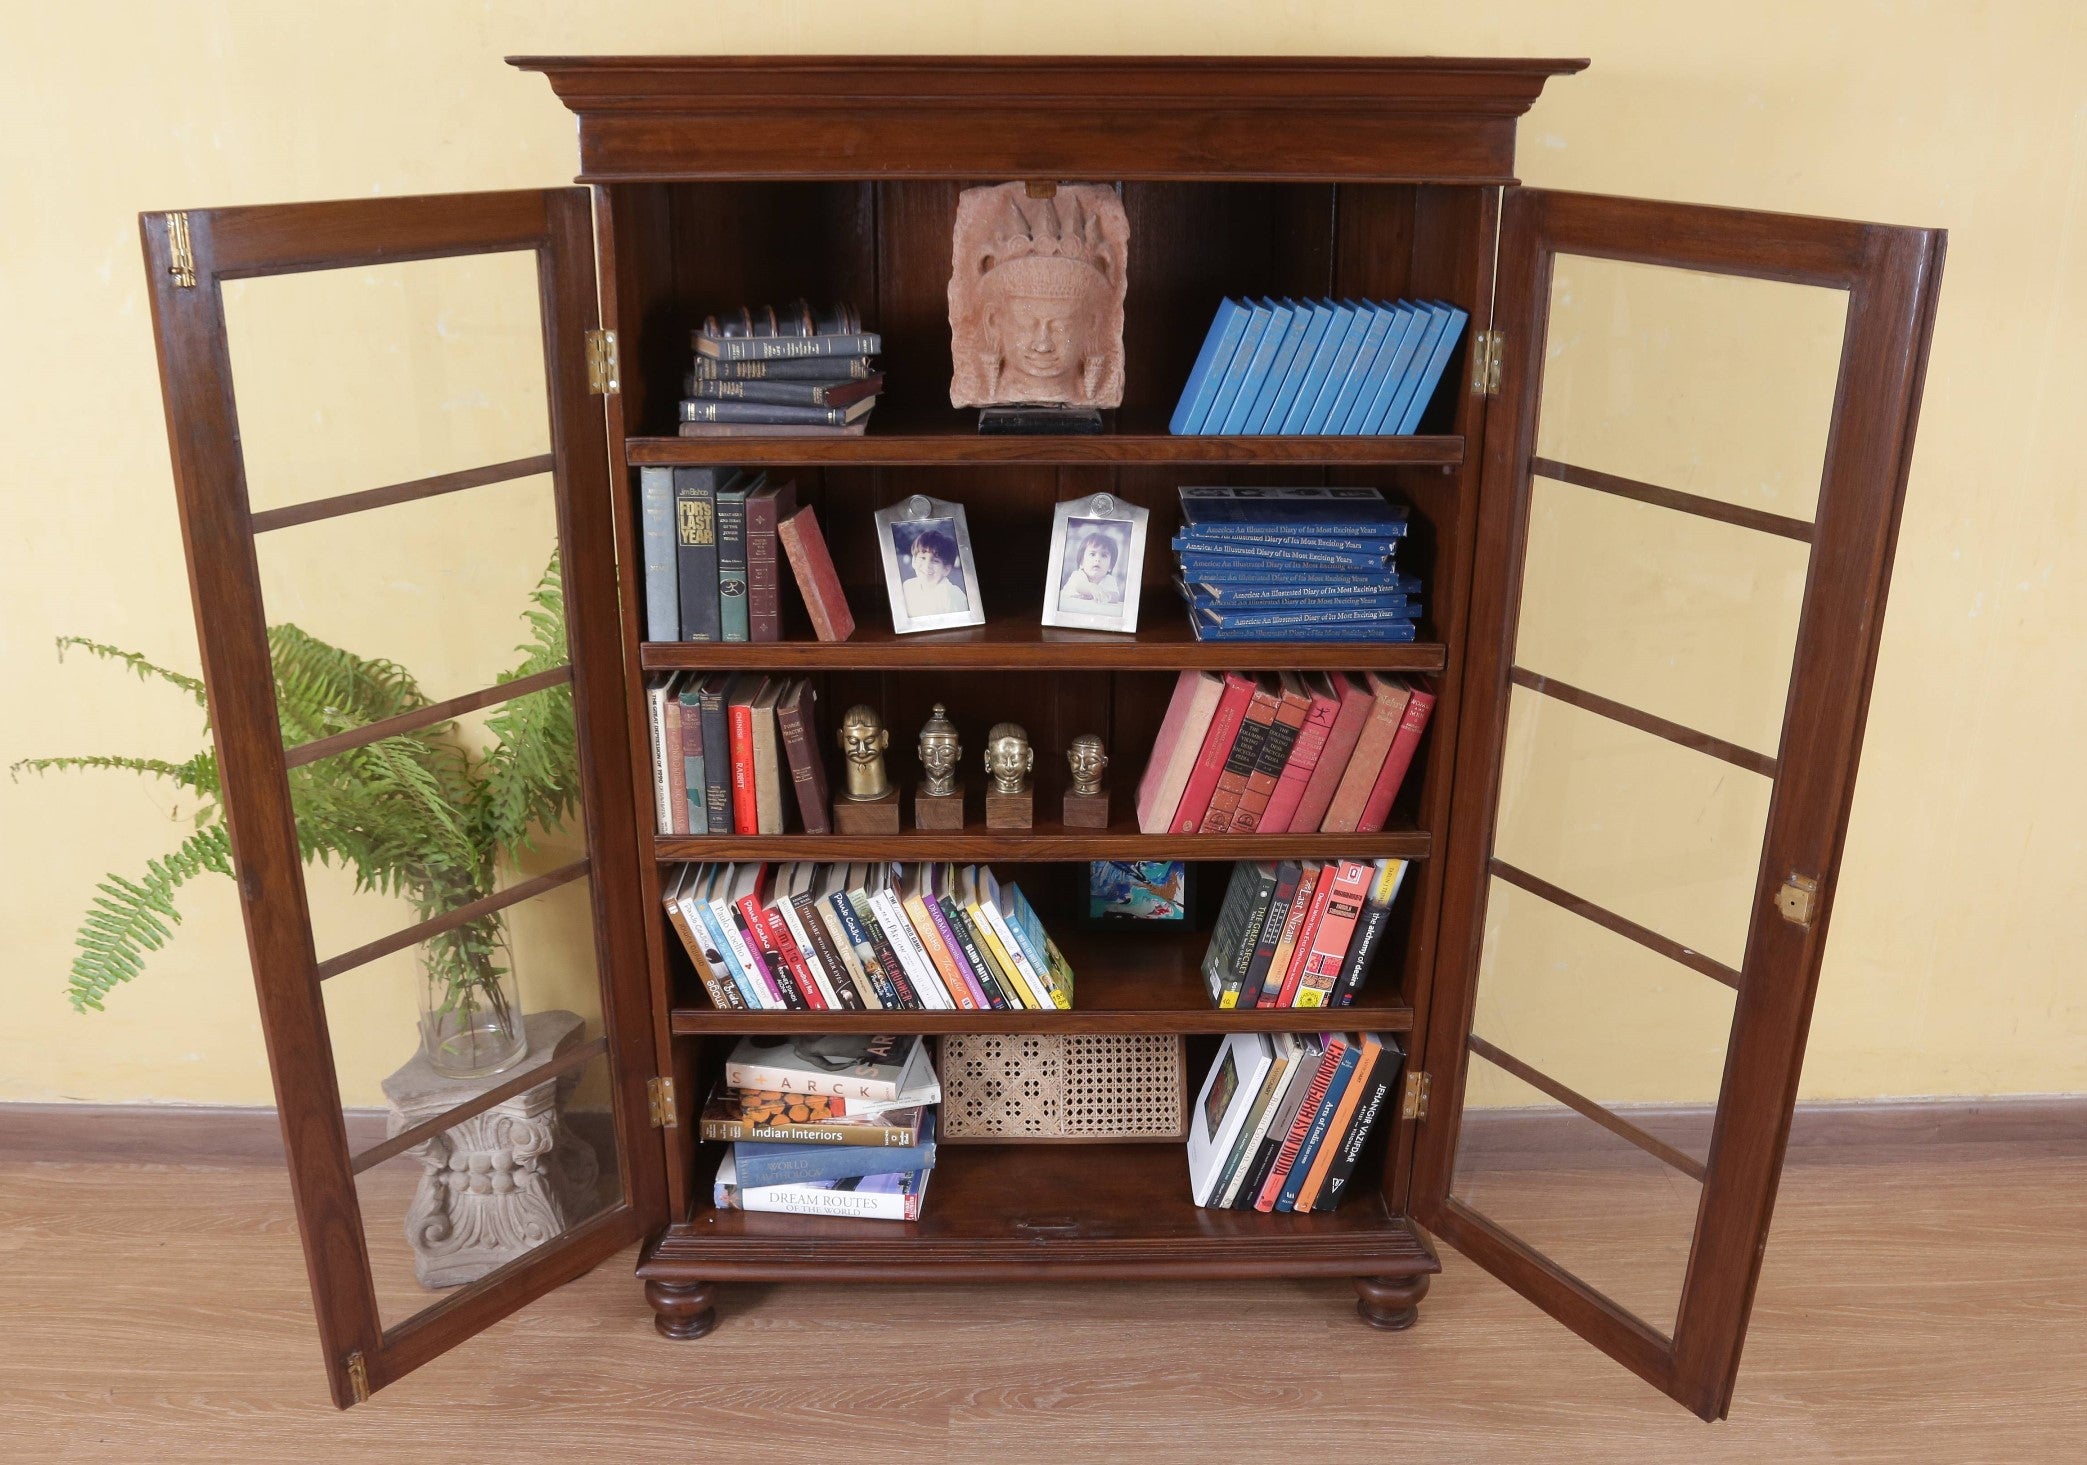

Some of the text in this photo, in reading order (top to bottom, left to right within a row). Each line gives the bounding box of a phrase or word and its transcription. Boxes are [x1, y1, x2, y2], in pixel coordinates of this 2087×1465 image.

[690, 488, 708, 496] Bishop
[680, 515, 712, 530] LAST
[681, 529, 713, 544] YEAR
[1185, 542, 1212, 550] America:
[1224, 545, 1254, 554] Illustrated
[1256, 548, 1273, 557] Diary
[1308, 553, 1334, 562] Exciting
[1303, 588, 1319, 596] Diary
[1353, 585, 1377, 594] Exciting
[654, 725, 662, 759] DEPRESSION
[656, 759, 662, 767] OF
[734, 761, 745, 789] RABBIT
[742, 898, 773, 949] Paulo Coelho
[832, 891, 862, 943] Paulo Coelho
[926, 903, 948, 934] DHARMA
[1283, 888, 1311, 944] Last Nizam
[715, 905, 745, 956] Paulo Coelho
[1238, 906, 1266, 976] THE GREAT SECRET
[801, 905, 812, 919] THE
[808, 918, 820, 937] HARE
[823, 948, 836, 969] AMBER
[833, 968, 844, 984] EYES
[1349, 912, 1379, 987] the alchemy of desire
[881, 950, 898, 971] KITE
[963, 942, 982, 964] BLIND
[973, 961, 992, 983] FAITH
[722, 980, 741, 1005] Brida
[889, 967, 914, 1002] RUNNER
[1300, 1043, 1342, 1119] CHANDIGARH
[1261, 1095, 1278, 1124] BRITISH
[1322, 1101, 1334, 1118] Arts
[1356, 1104, 1367, 1121] ARTIST
[1293, 1117, 1310, 1133] IS
[1317, 1117, 1327, 1127] of
[1346, 1082, 1386, 1164] JEHANGIR VAZIFDAR
[752, 1128, 789, 1139] Indian
[792, 1128, 843, 1140] Interiors
[1243, 1126, 1263, 1161] COLONIAL
[1287, 1130, 1305, 1146] IN
[1308, 1125, 1322, 1145] India
[768, 1160, 808, 1170] WORLD
[1273, 1146, 1297, 1178] INDIA
[1231, 1164, 1246, 1185] STYLE
[770, 1192, 878, 1209] DREAM ROUTES
[786, 1204, 799, 1212] OF
[824, 1207, 861, 1216] WORLD
